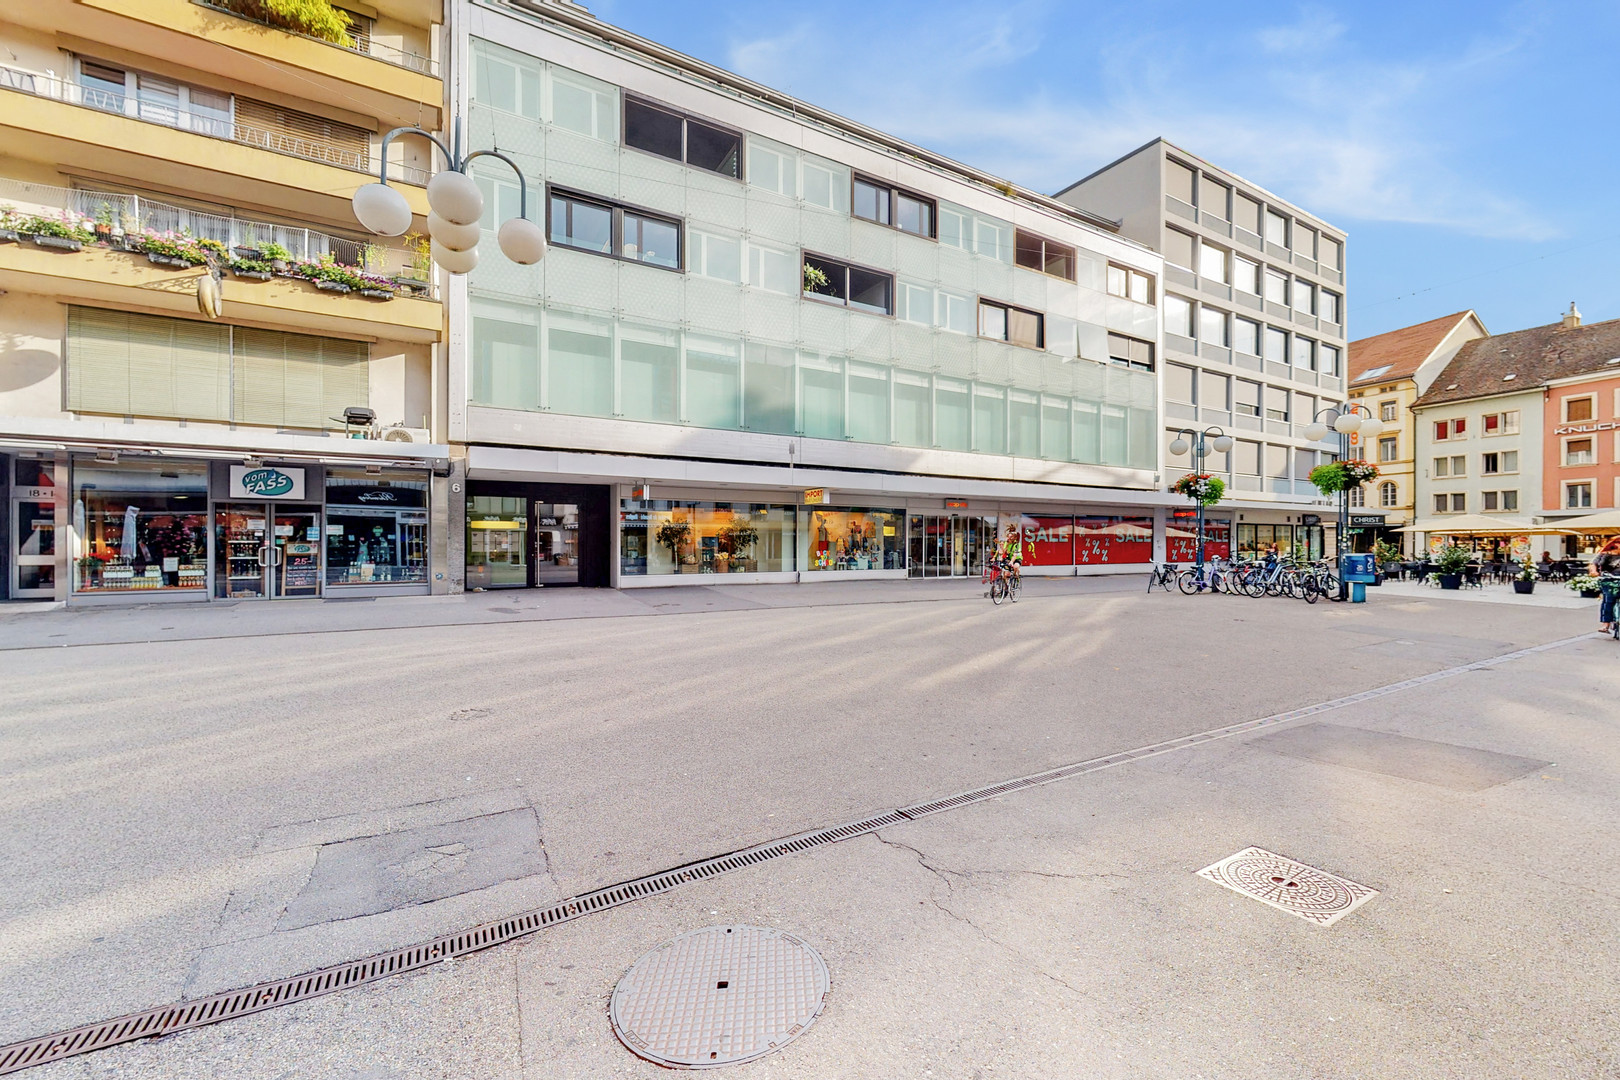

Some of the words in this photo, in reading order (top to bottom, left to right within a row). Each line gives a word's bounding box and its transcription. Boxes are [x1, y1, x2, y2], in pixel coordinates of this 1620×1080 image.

[245, 472, 267, 482] vom
[246, 476, 287, 495] FASS
[452, 483, 460, 493] 6
[1353, 516, 1380, 524] CHRIST
[1024, 526, 1069, 543] SALE
[1115, 527, 1152, 543] SALE
